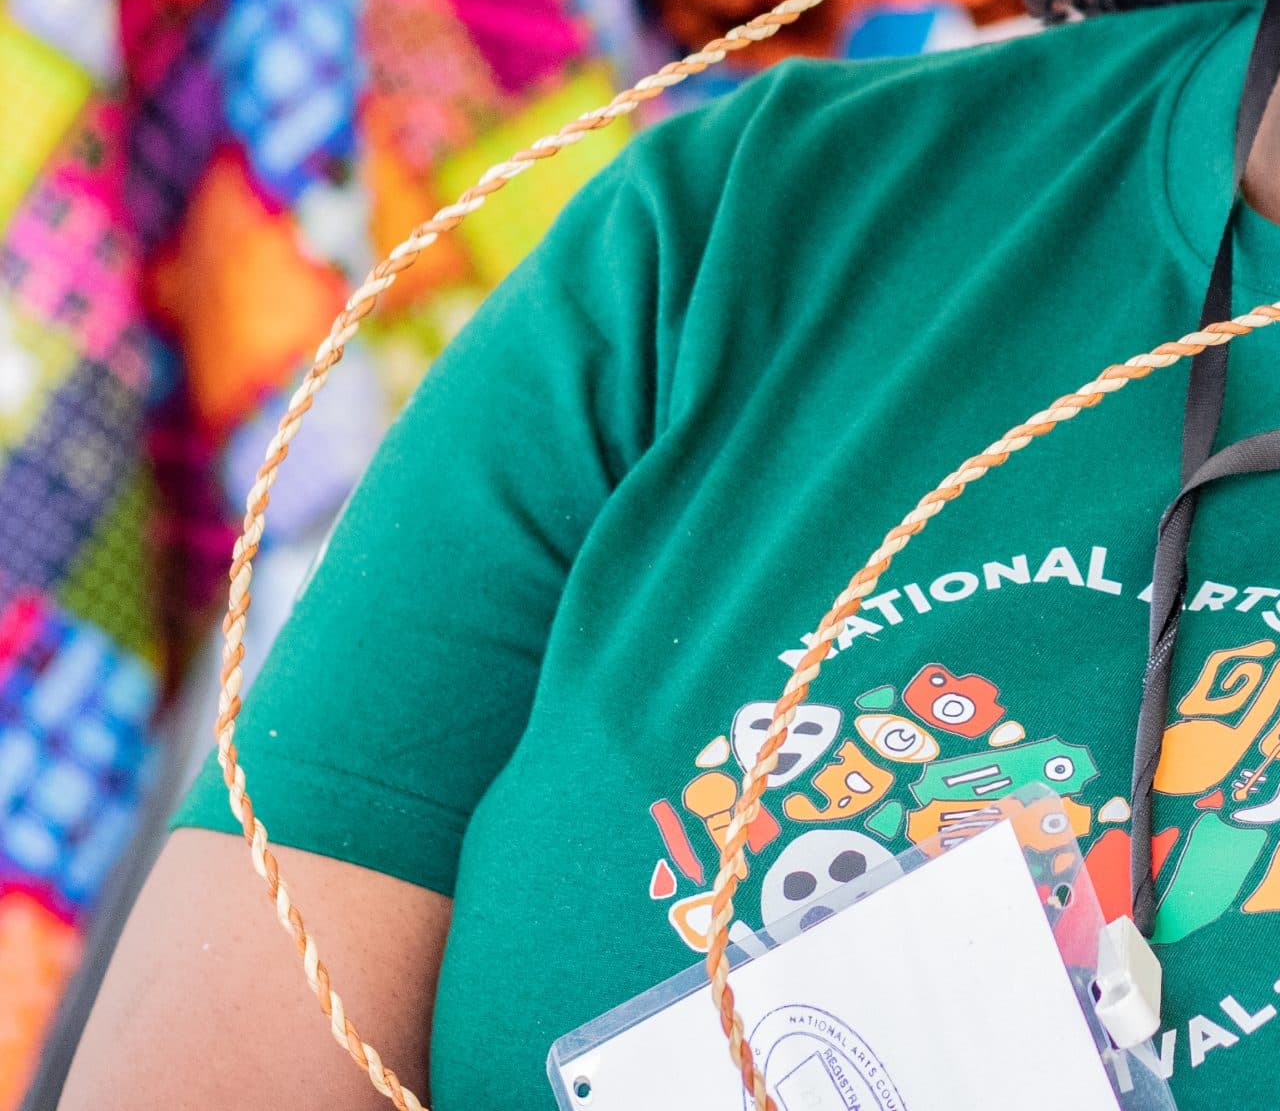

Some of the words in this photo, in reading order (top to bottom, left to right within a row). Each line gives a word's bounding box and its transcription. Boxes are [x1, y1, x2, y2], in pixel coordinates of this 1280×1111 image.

[789, 1015, 848, 1048] NATIONAL
[850, 1046, 878, 1078] ARTS
[876, 1079, 899, 1111] COU
